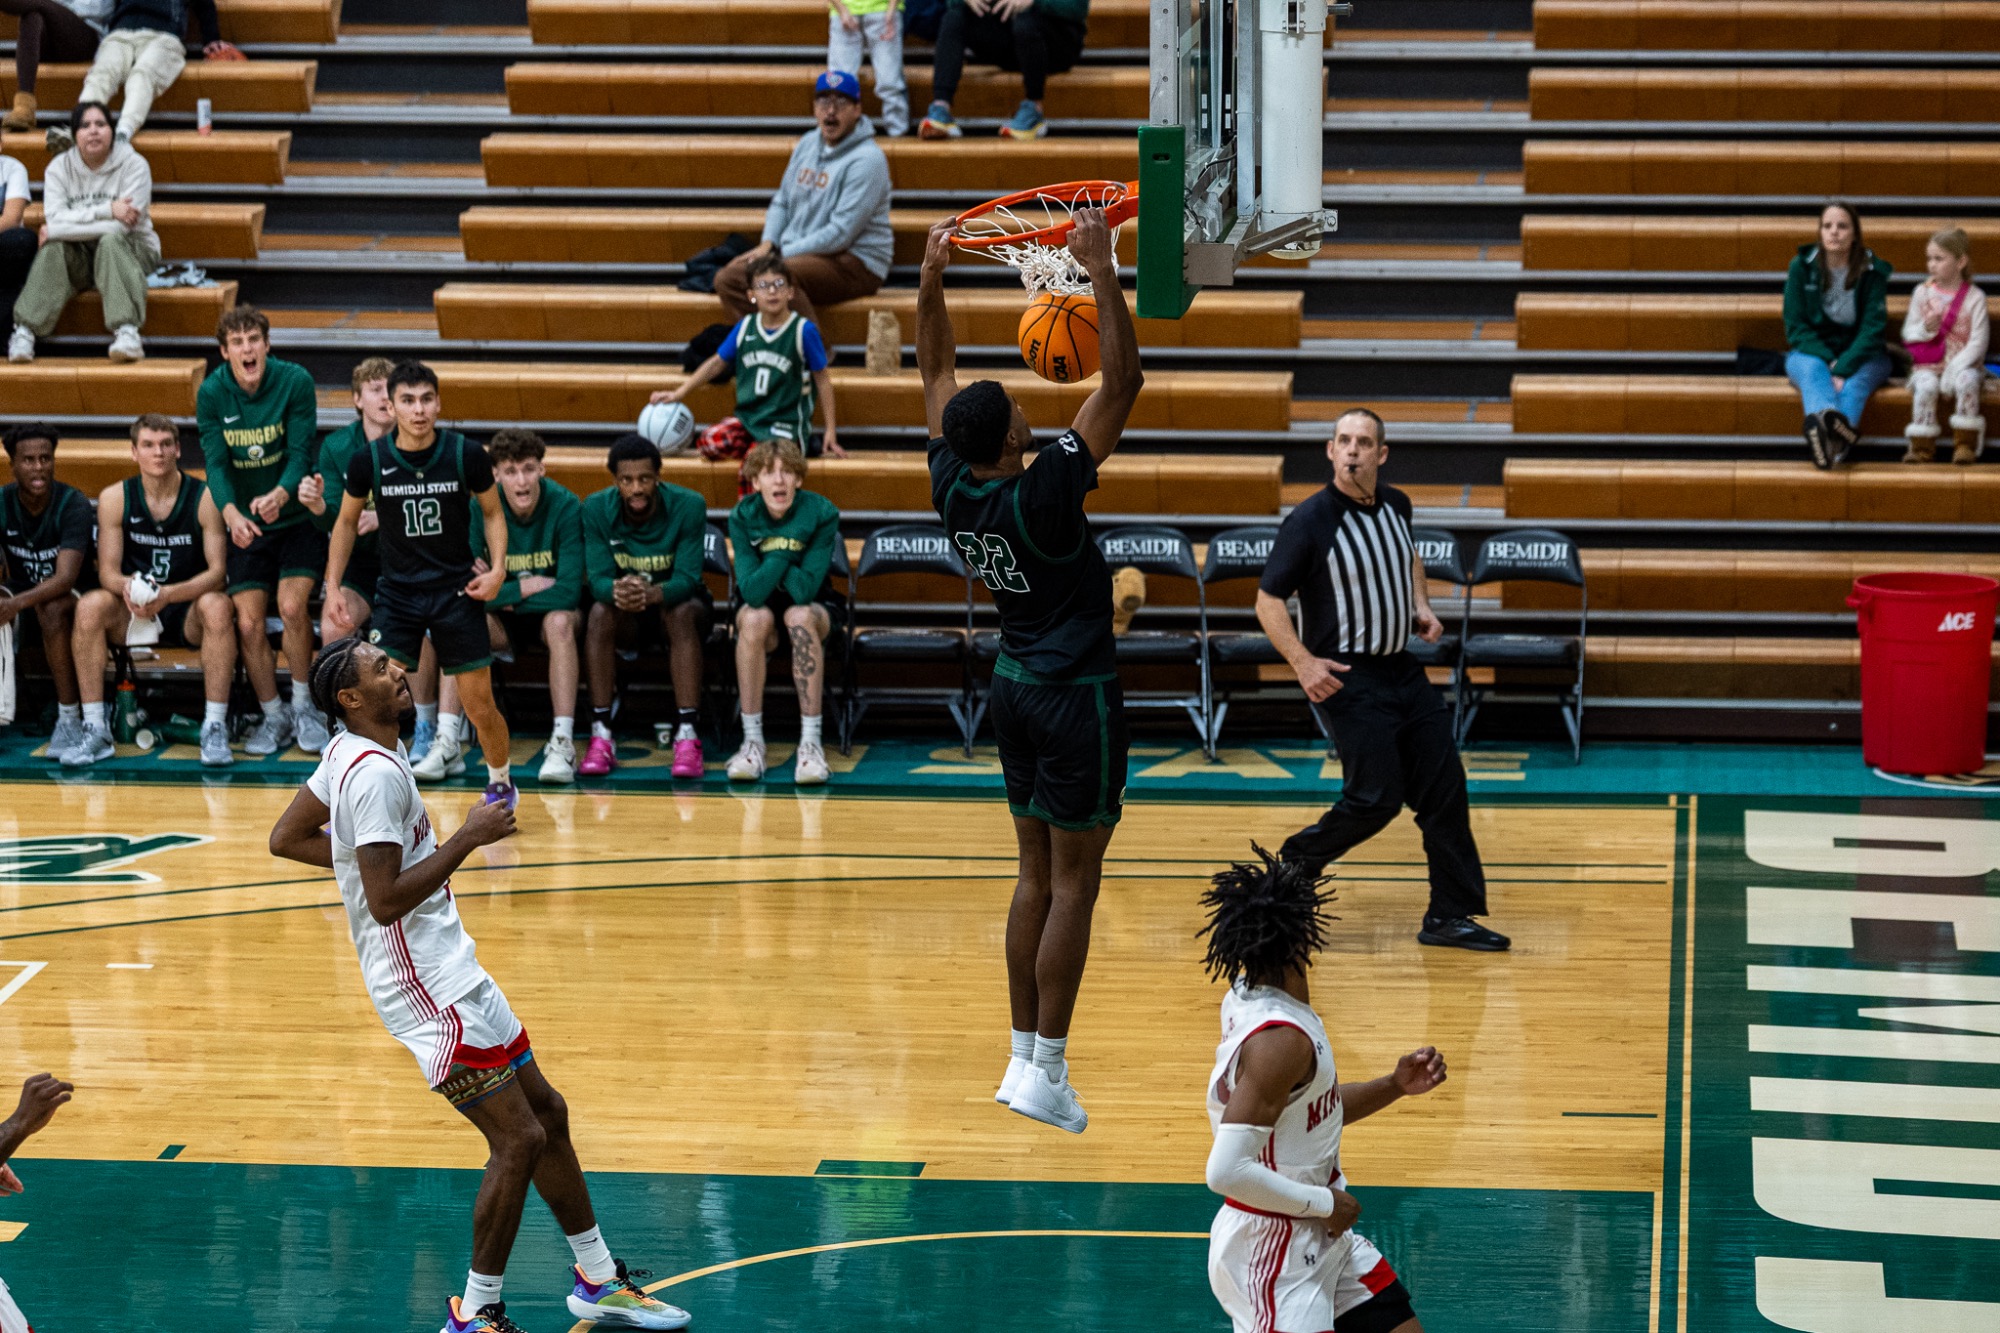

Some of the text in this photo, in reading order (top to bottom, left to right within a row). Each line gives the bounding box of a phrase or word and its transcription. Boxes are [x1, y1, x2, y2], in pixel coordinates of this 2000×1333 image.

[755, 366, 771, 396] 0
[223, 428, 264, 447] NOTHNG
[381, 480, 459, 497] BEMIDJI STATE
[402, 497, 443, 538] 12
[167, 534, 193, 546] SATE
[876, 536, 950, 555] BEMIDJI
[1105, 538, 1181, 560] BEMIDJI
[1413, 540, 1455, 561] IDJI
[8, 544, 38, 561] EMIDJI
[613, 551, 652, 573] NOING
[954, 531, 1031, 593] 22
[1487, 541, 1569, 562] BEMIDJI
[150, 548, 171, 582] 5
[504, 553, 533, 573] THING
[1937, 610, 1976, 632] ACE
[1307, 1072, 1341, 1133] MIN
